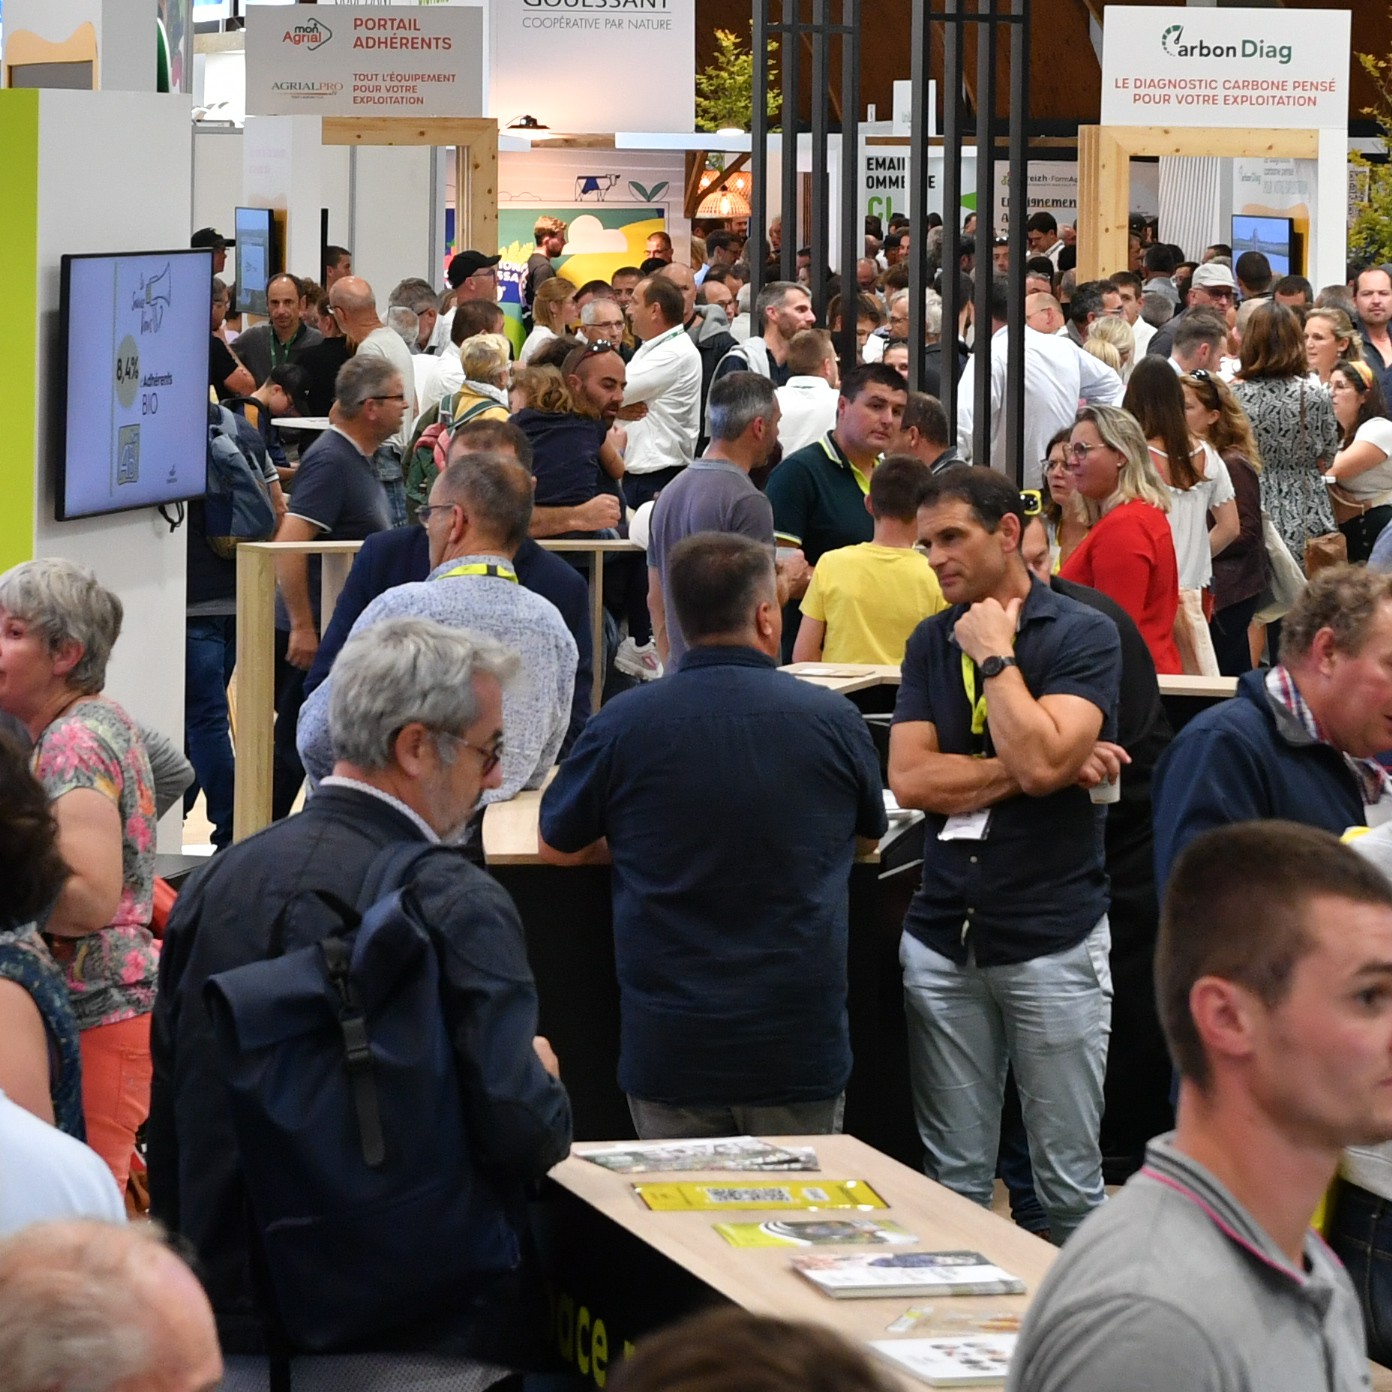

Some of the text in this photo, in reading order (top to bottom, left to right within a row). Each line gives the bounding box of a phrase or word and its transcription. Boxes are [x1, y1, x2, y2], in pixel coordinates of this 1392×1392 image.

[353, 17, 421, 31] PORTAIL
[522, 15, 672, 31] COOPÉRATIVE PAR NATURE
[283, 31, 322, 46] Agrial
[353, 33, 452, 50] ADHÉRENTS
[1241, 39, 1292, 64] Diag
[353, 71, 456, 83] TOUT L'ÉQUIPEMENT
[353, 85, 418, 94] POUR VOTRE
[1114, 78, 1336, 92] LE DIAGNOSTIC CARBONE PENSÉ
[353, 96, 425, 105] EXPLOITATION
[1133, 93, 1317, 107] POUR VOTRE EXPLOITATION
[116, 357, 139, 385] 8,4%
[142, 392, 158, 416] BIO
